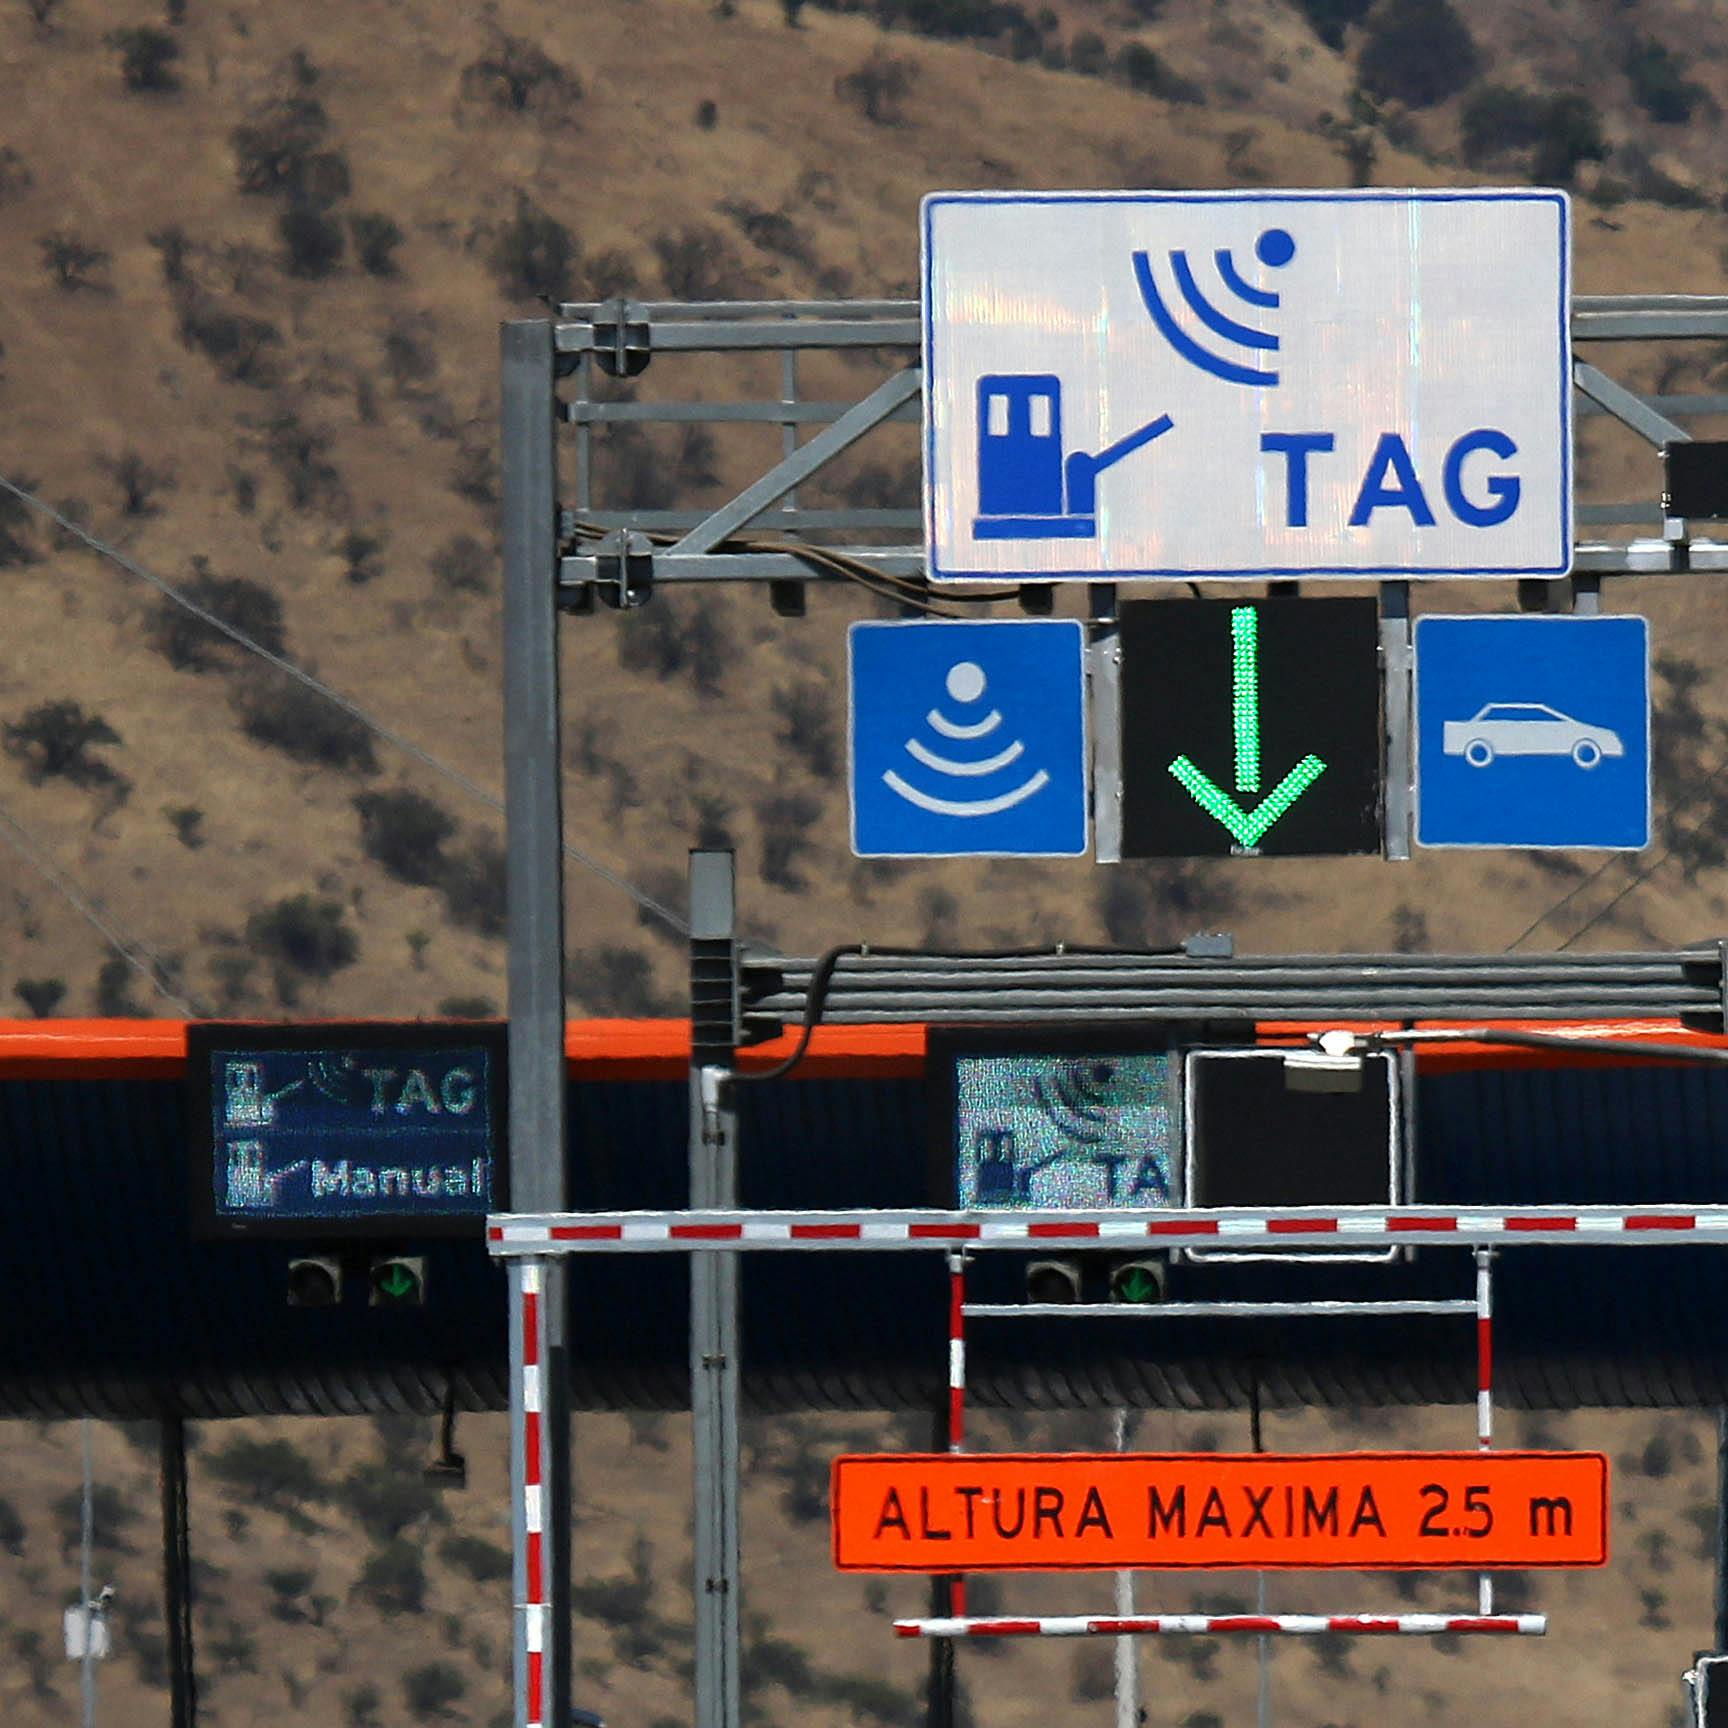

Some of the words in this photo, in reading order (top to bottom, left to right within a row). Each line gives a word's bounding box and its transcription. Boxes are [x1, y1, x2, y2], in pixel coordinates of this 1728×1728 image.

[1259, 428, 1521, 528] TAG
[359, 1066, 475, 1114] TAG
[310, 1156, 482, 1198] Manual
[873, 1485, 1114, 1540] ALTURA
[1147, 1484, 1388, 1539] MAXIMA
[1418, 1484, 1494, 1538] 2.5
[1529, 1496, 1573, 1537] m
